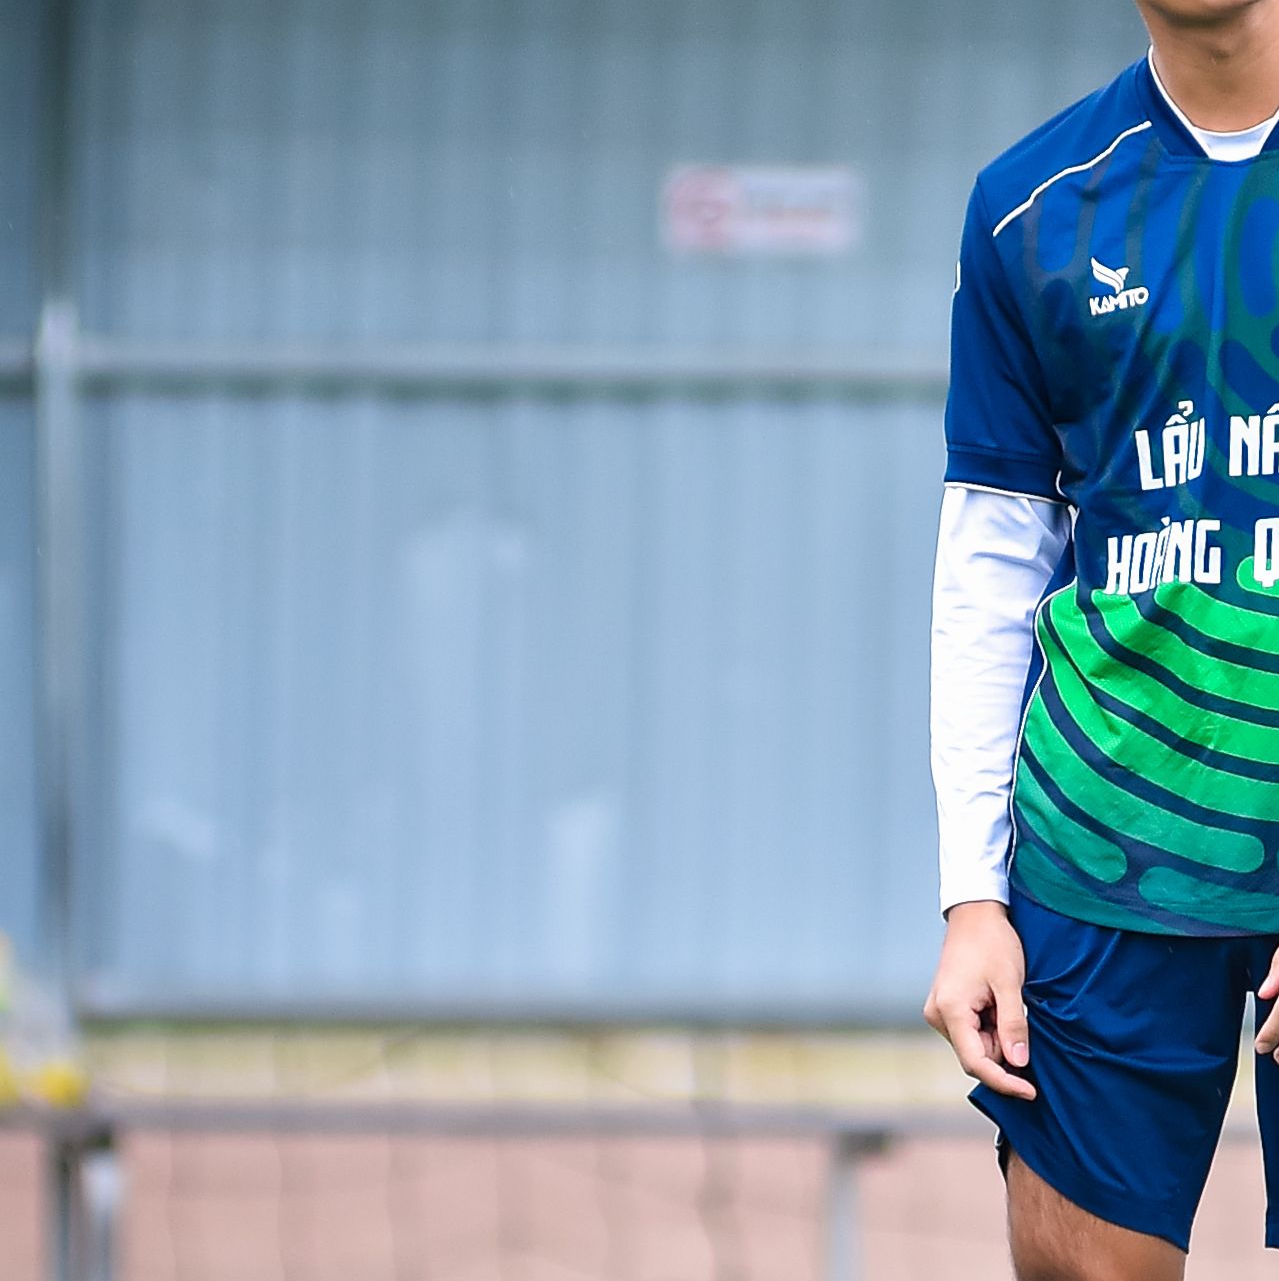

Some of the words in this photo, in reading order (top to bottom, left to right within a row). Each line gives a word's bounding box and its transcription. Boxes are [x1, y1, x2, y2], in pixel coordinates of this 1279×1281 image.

[1089, 286, 1150, 316] KAMITO
[1135, 400, 1206, 491] LẨU
[1103, 516, 1222, 595] HOÀNG
